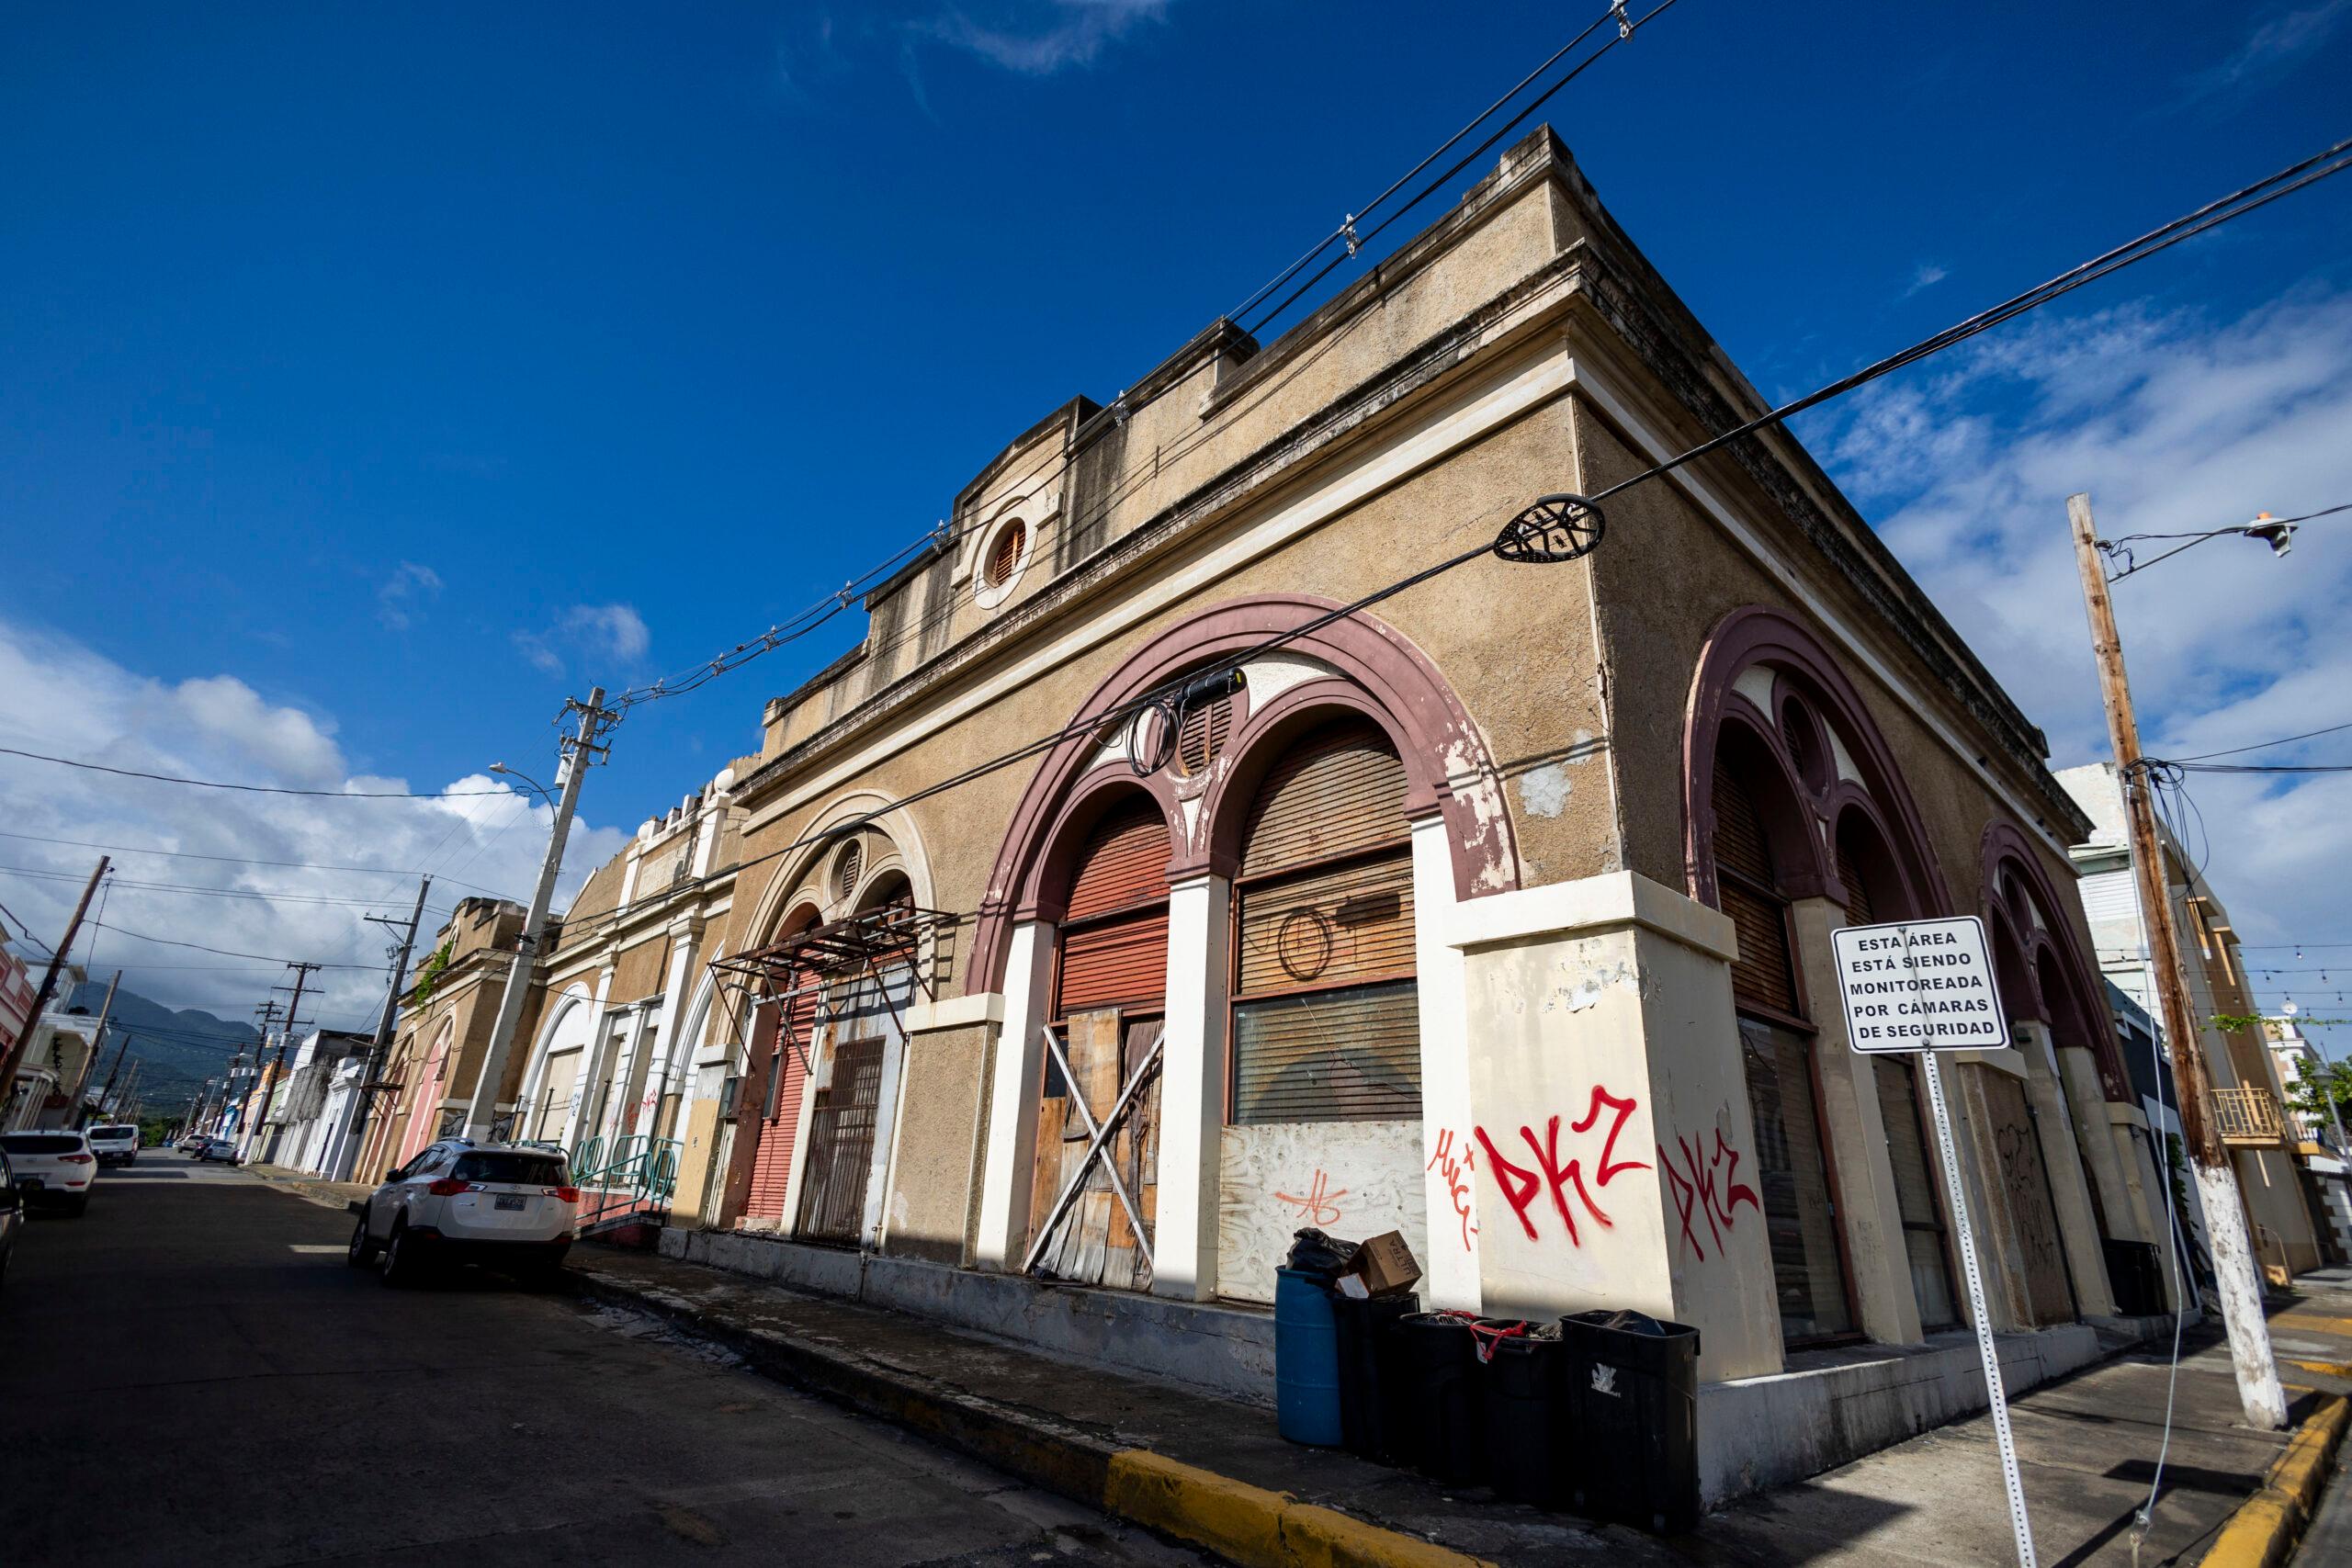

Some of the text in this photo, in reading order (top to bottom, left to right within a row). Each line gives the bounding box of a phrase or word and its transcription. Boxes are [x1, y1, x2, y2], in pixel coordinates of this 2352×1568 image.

[1858, 931, 1958, 952] ESTA ÁREA
[1851, 953, 1972, 973] ESTÁ SIENDO
[1849, 975, 1984, 996] MONITOREADA
[1853, 998, 1989, 1018] POR CÁMARAS
[1859, 1021, 1995, 1039] DE SEGURIDAD
[1388, 1238, 1412, 1276] ULTRA
